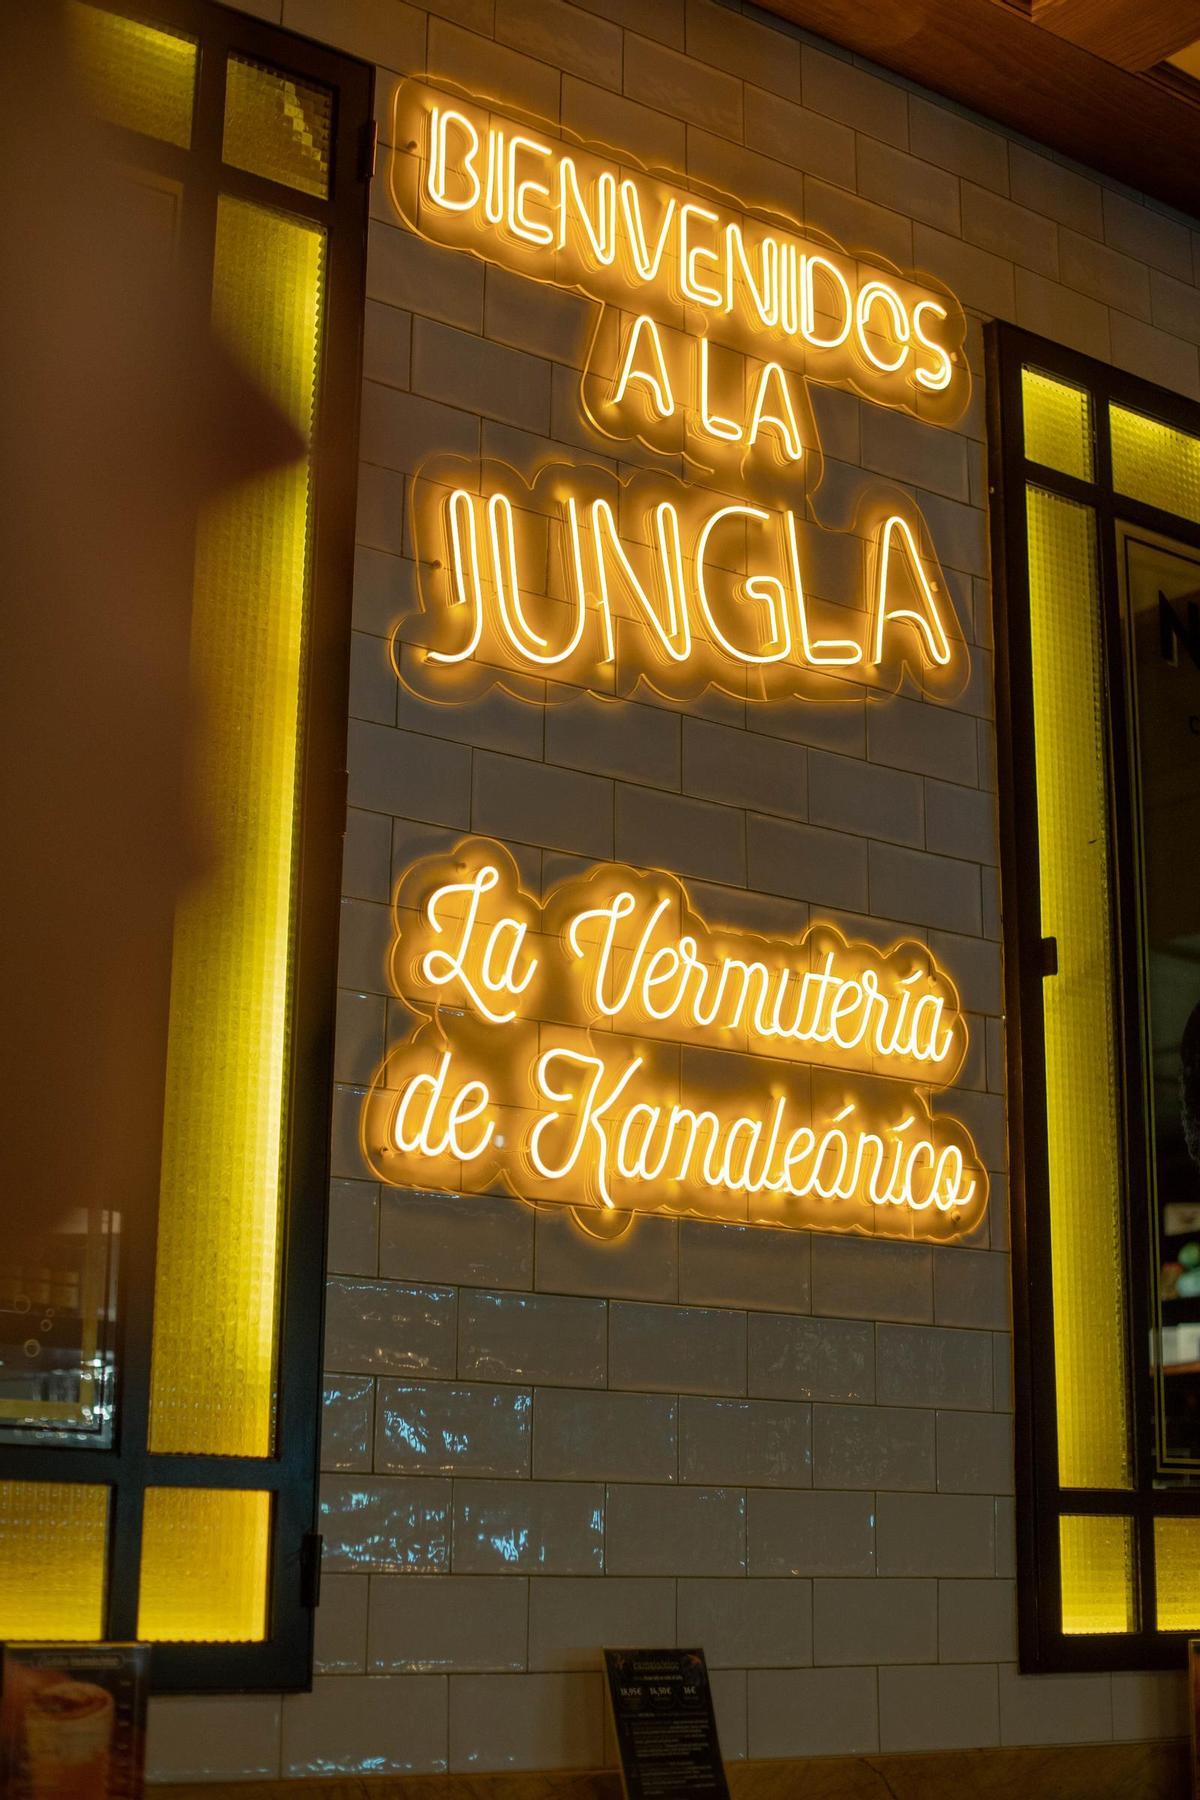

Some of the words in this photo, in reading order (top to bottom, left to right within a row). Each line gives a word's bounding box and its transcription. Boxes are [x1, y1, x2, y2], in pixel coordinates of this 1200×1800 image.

[427, 106, 952, 391] BIENVENIDOS
[608, 315, 675, 417] A
[700, 336, 803, 461] LA
[426, 489, 952, 665] JUNGLA
[422, 865, 538, 1023] La
[569, 891, 954, 1063] Vermutería
[394, 1051, 495, 1161] de
